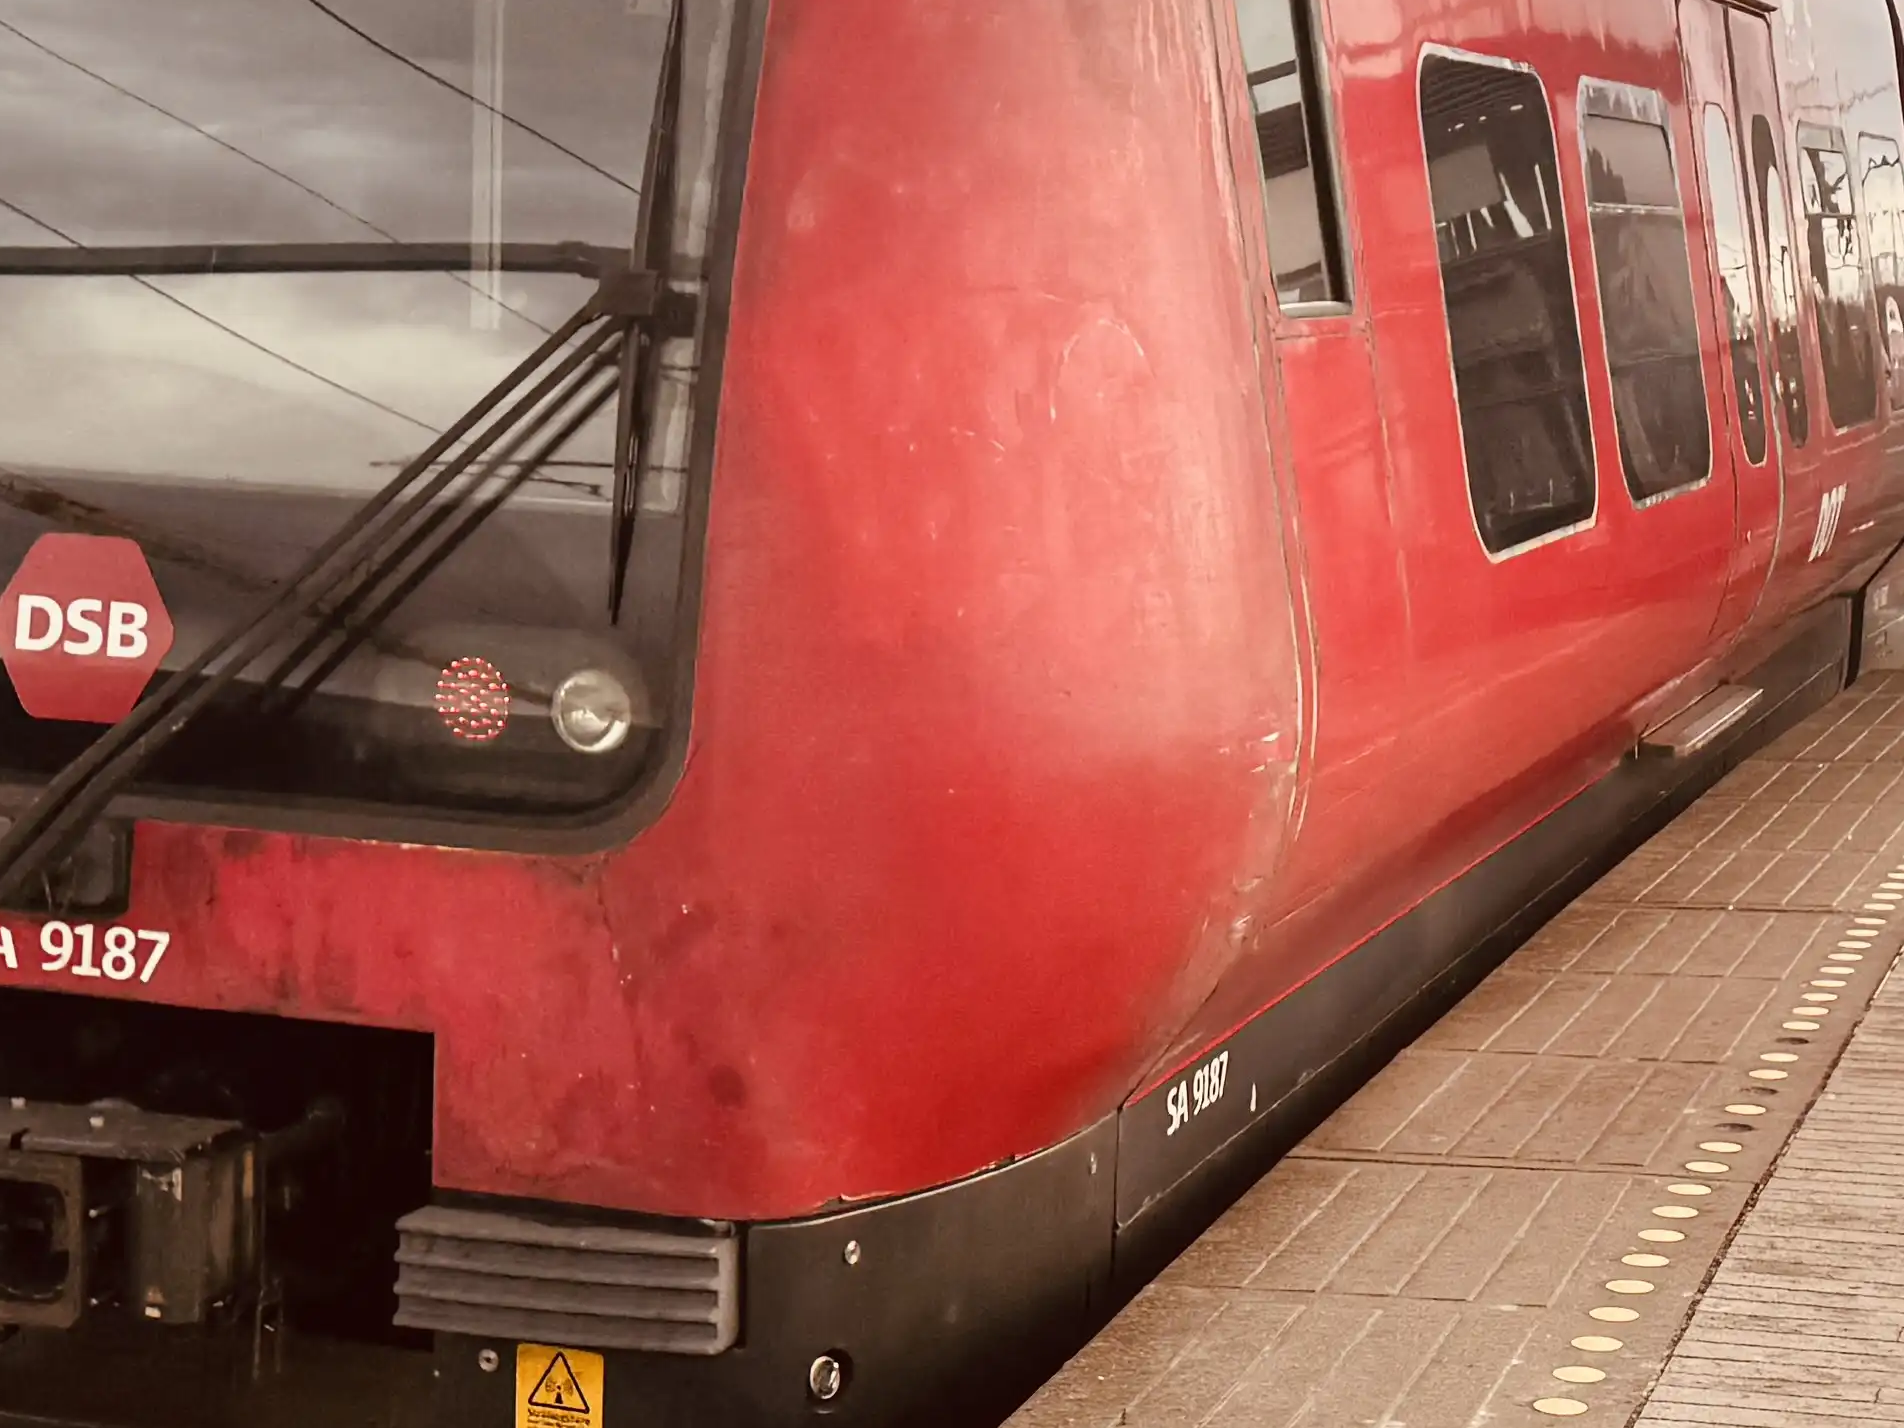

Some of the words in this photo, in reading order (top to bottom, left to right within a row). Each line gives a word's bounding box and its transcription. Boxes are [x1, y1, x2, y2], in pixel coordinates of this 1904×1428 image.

[14, 595, 149, 659] DSB
[40, 920, 170, 983] 9187
[1166, 1080, 1189, 1136] SA
[1193, 1050, 1229, 1116] 9187
